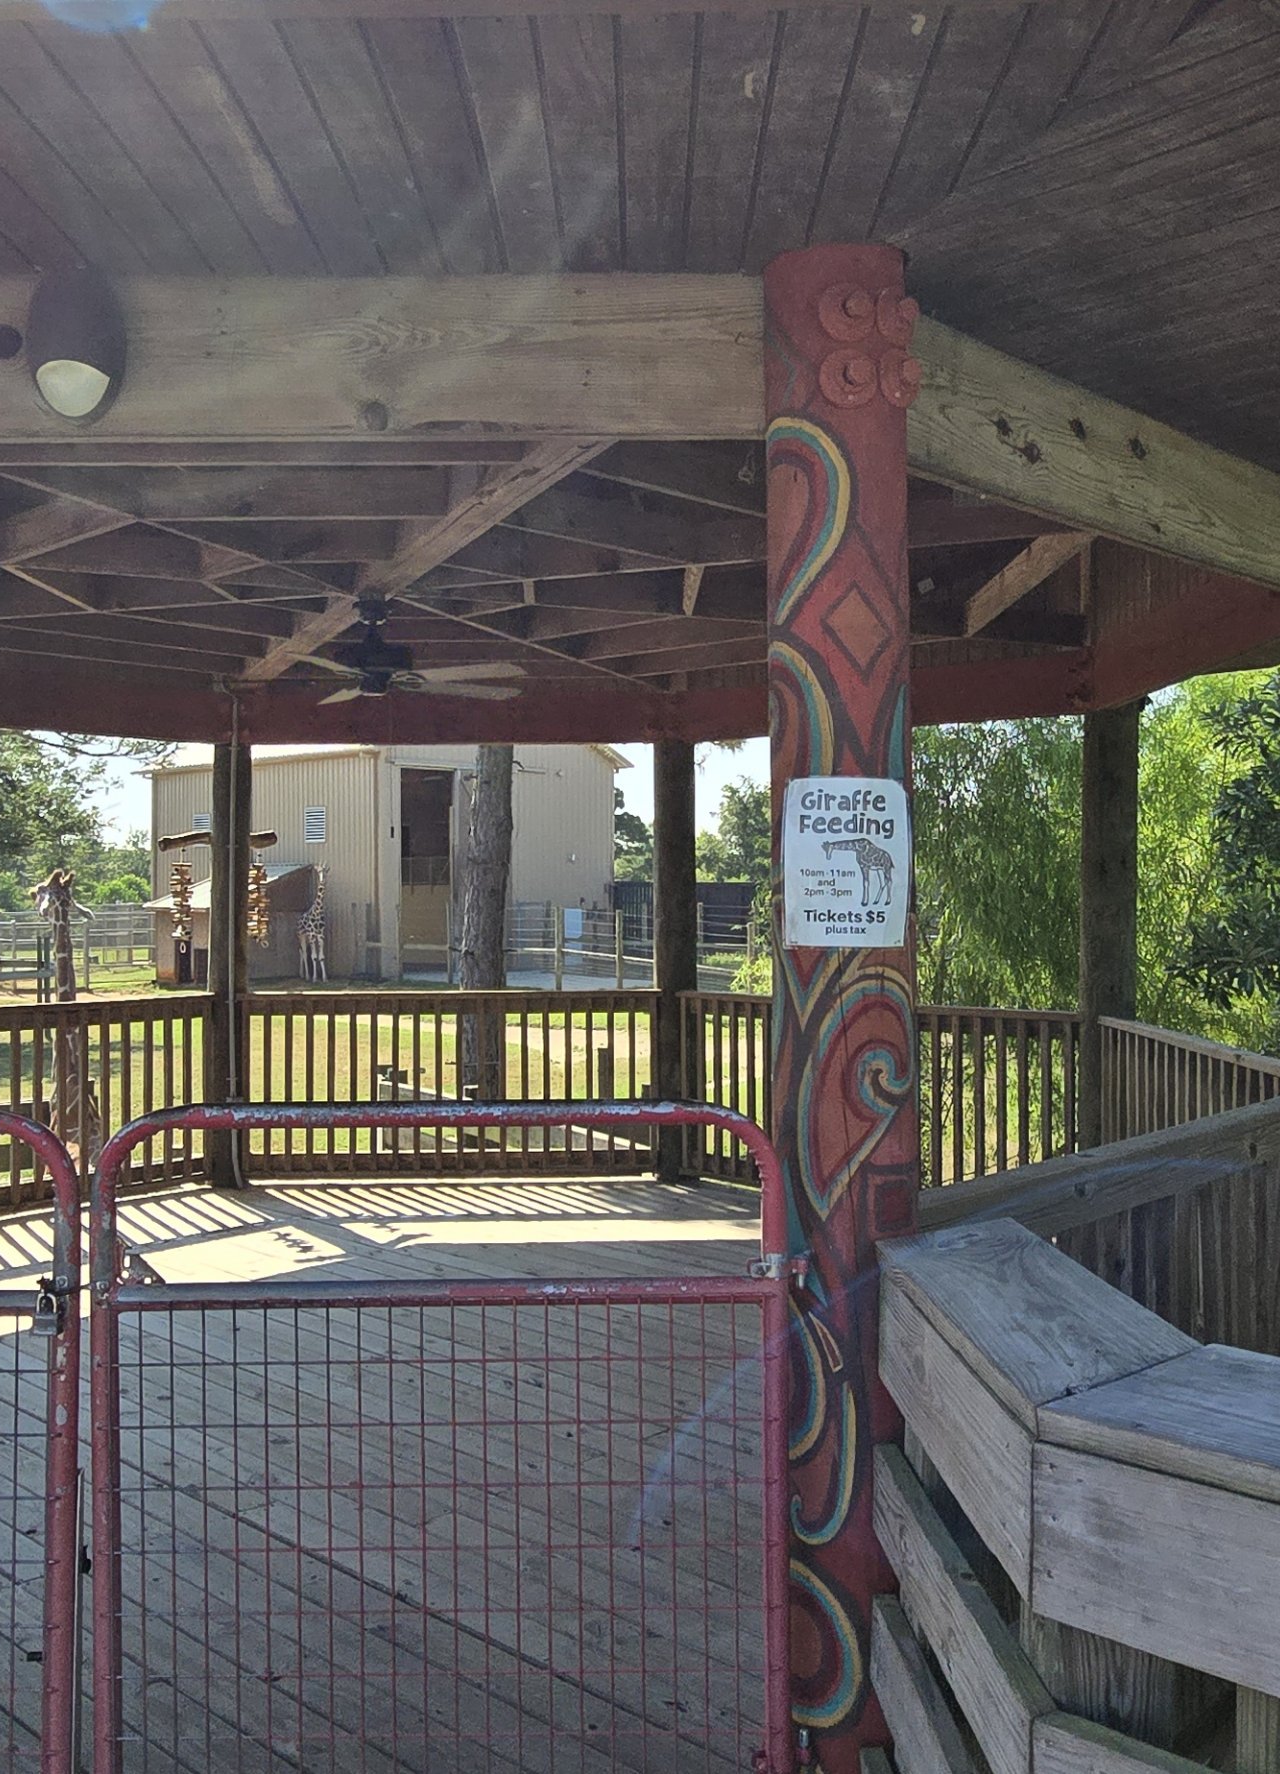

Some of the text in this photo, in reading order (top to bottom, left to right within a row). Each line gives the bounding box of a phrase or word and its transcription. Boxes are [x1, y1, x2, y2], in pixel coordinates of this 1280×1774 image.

[800, 788, 887, 812] Giraffe
[798, 812, 895, 839] Feeding
[800, 868, 825, 878] 10am
[830, 868, 856, 878] 11am
[817, 878, 836, 887] and
[804, 887, 825, 898] 2pm
[830, 887, 853, 898] 3pm
[803, 909, 886, 925] Tickets $5
[825, 925, 867, 935] plus tax
